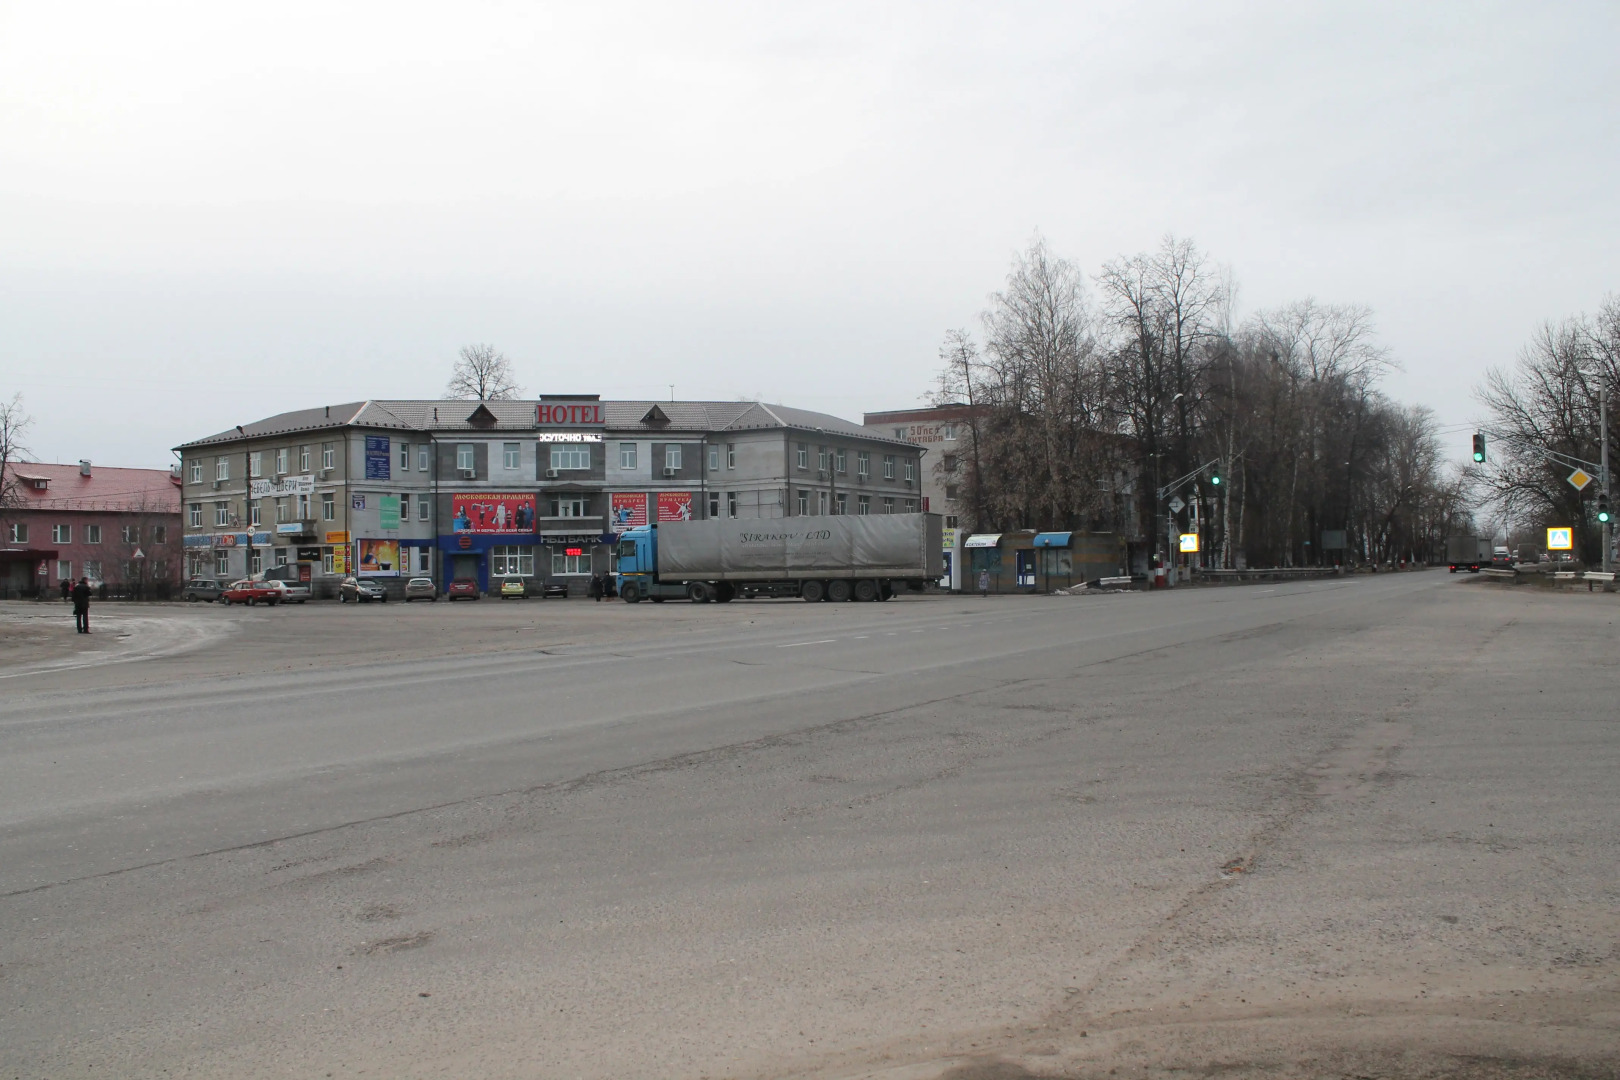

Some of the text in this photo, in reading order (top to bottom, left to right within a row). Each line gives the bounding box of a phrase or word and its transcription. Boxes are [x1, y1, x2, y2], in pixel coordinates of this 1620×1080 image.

[537, 405, 605, 423] HOTEL
[910, 426, 922, 436] 50
[805, 530, 830, 540] LTD
